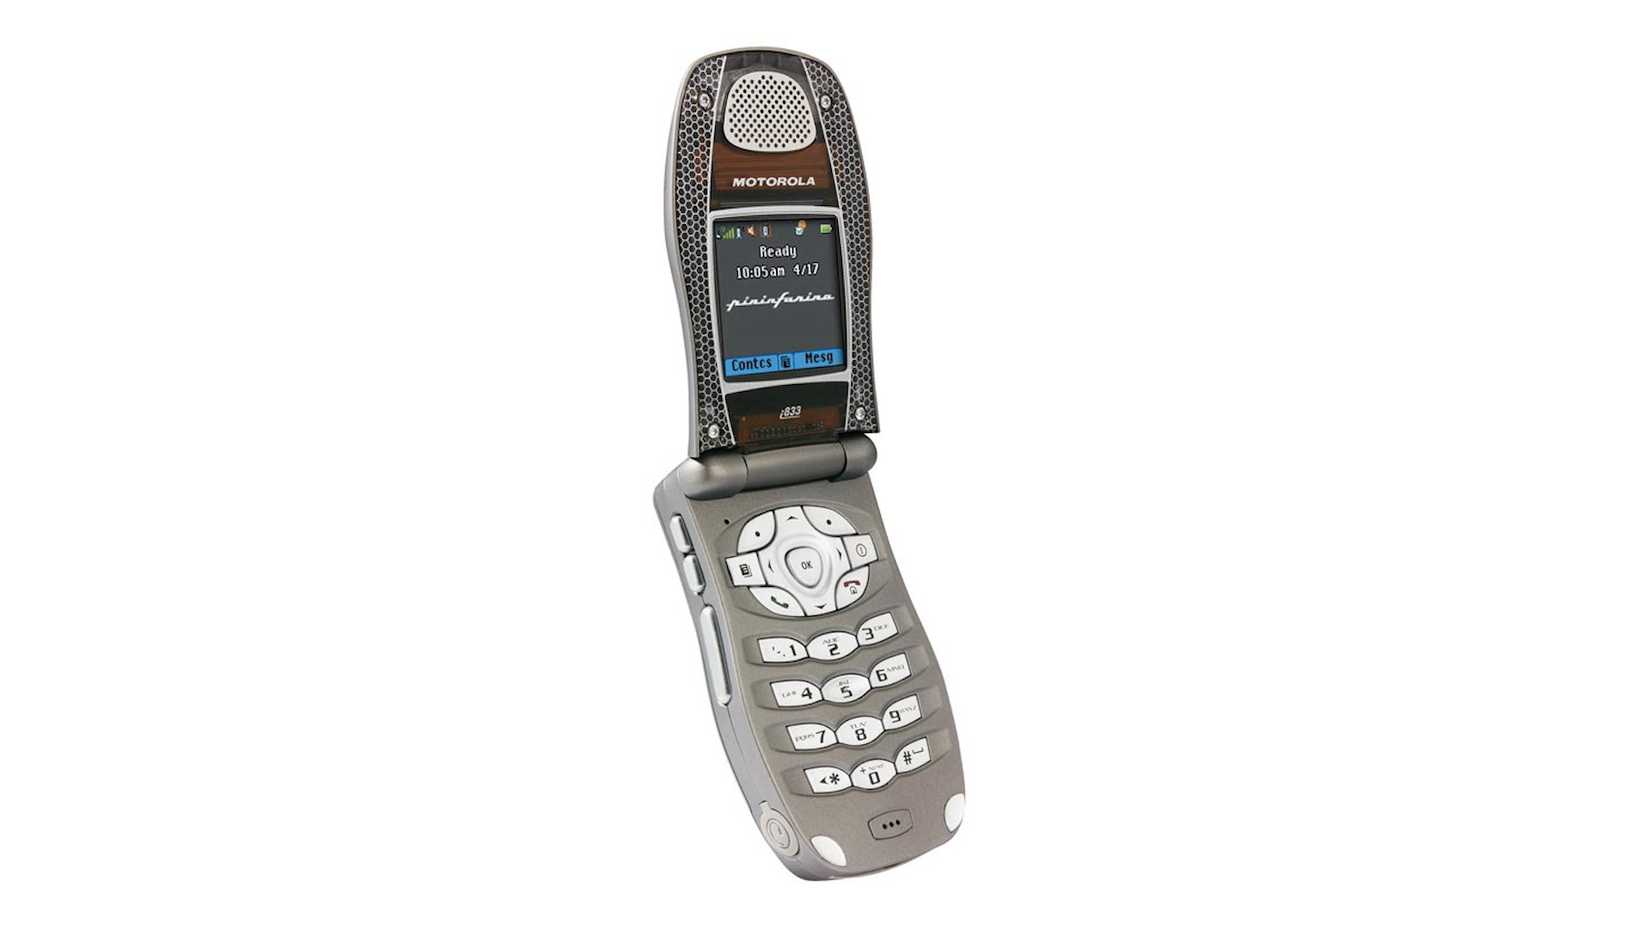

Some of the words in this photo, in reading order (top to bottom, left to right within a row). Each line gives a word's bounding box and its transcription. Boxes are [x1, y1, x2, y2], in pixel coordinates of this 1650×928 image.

[732, 176, 817, 188] MOTOROLA
[759, 245, 797, 259] Ready
[793, 262, 820, 276] 4/17
[801, 560, 814, 571] OK
[861, 627, 875, 641] 3
[789, 644, 797, 657] 1
[827, 643, 841, 656] 2
[876, 669, 888, 682] 6
[801, 687, 813, 700] 4
[840, 686, 853, 699] 5
[889, 710, 901, 723] 9
[816, 730, 826, 744] 7
[855, 728, 868, 741] 8
